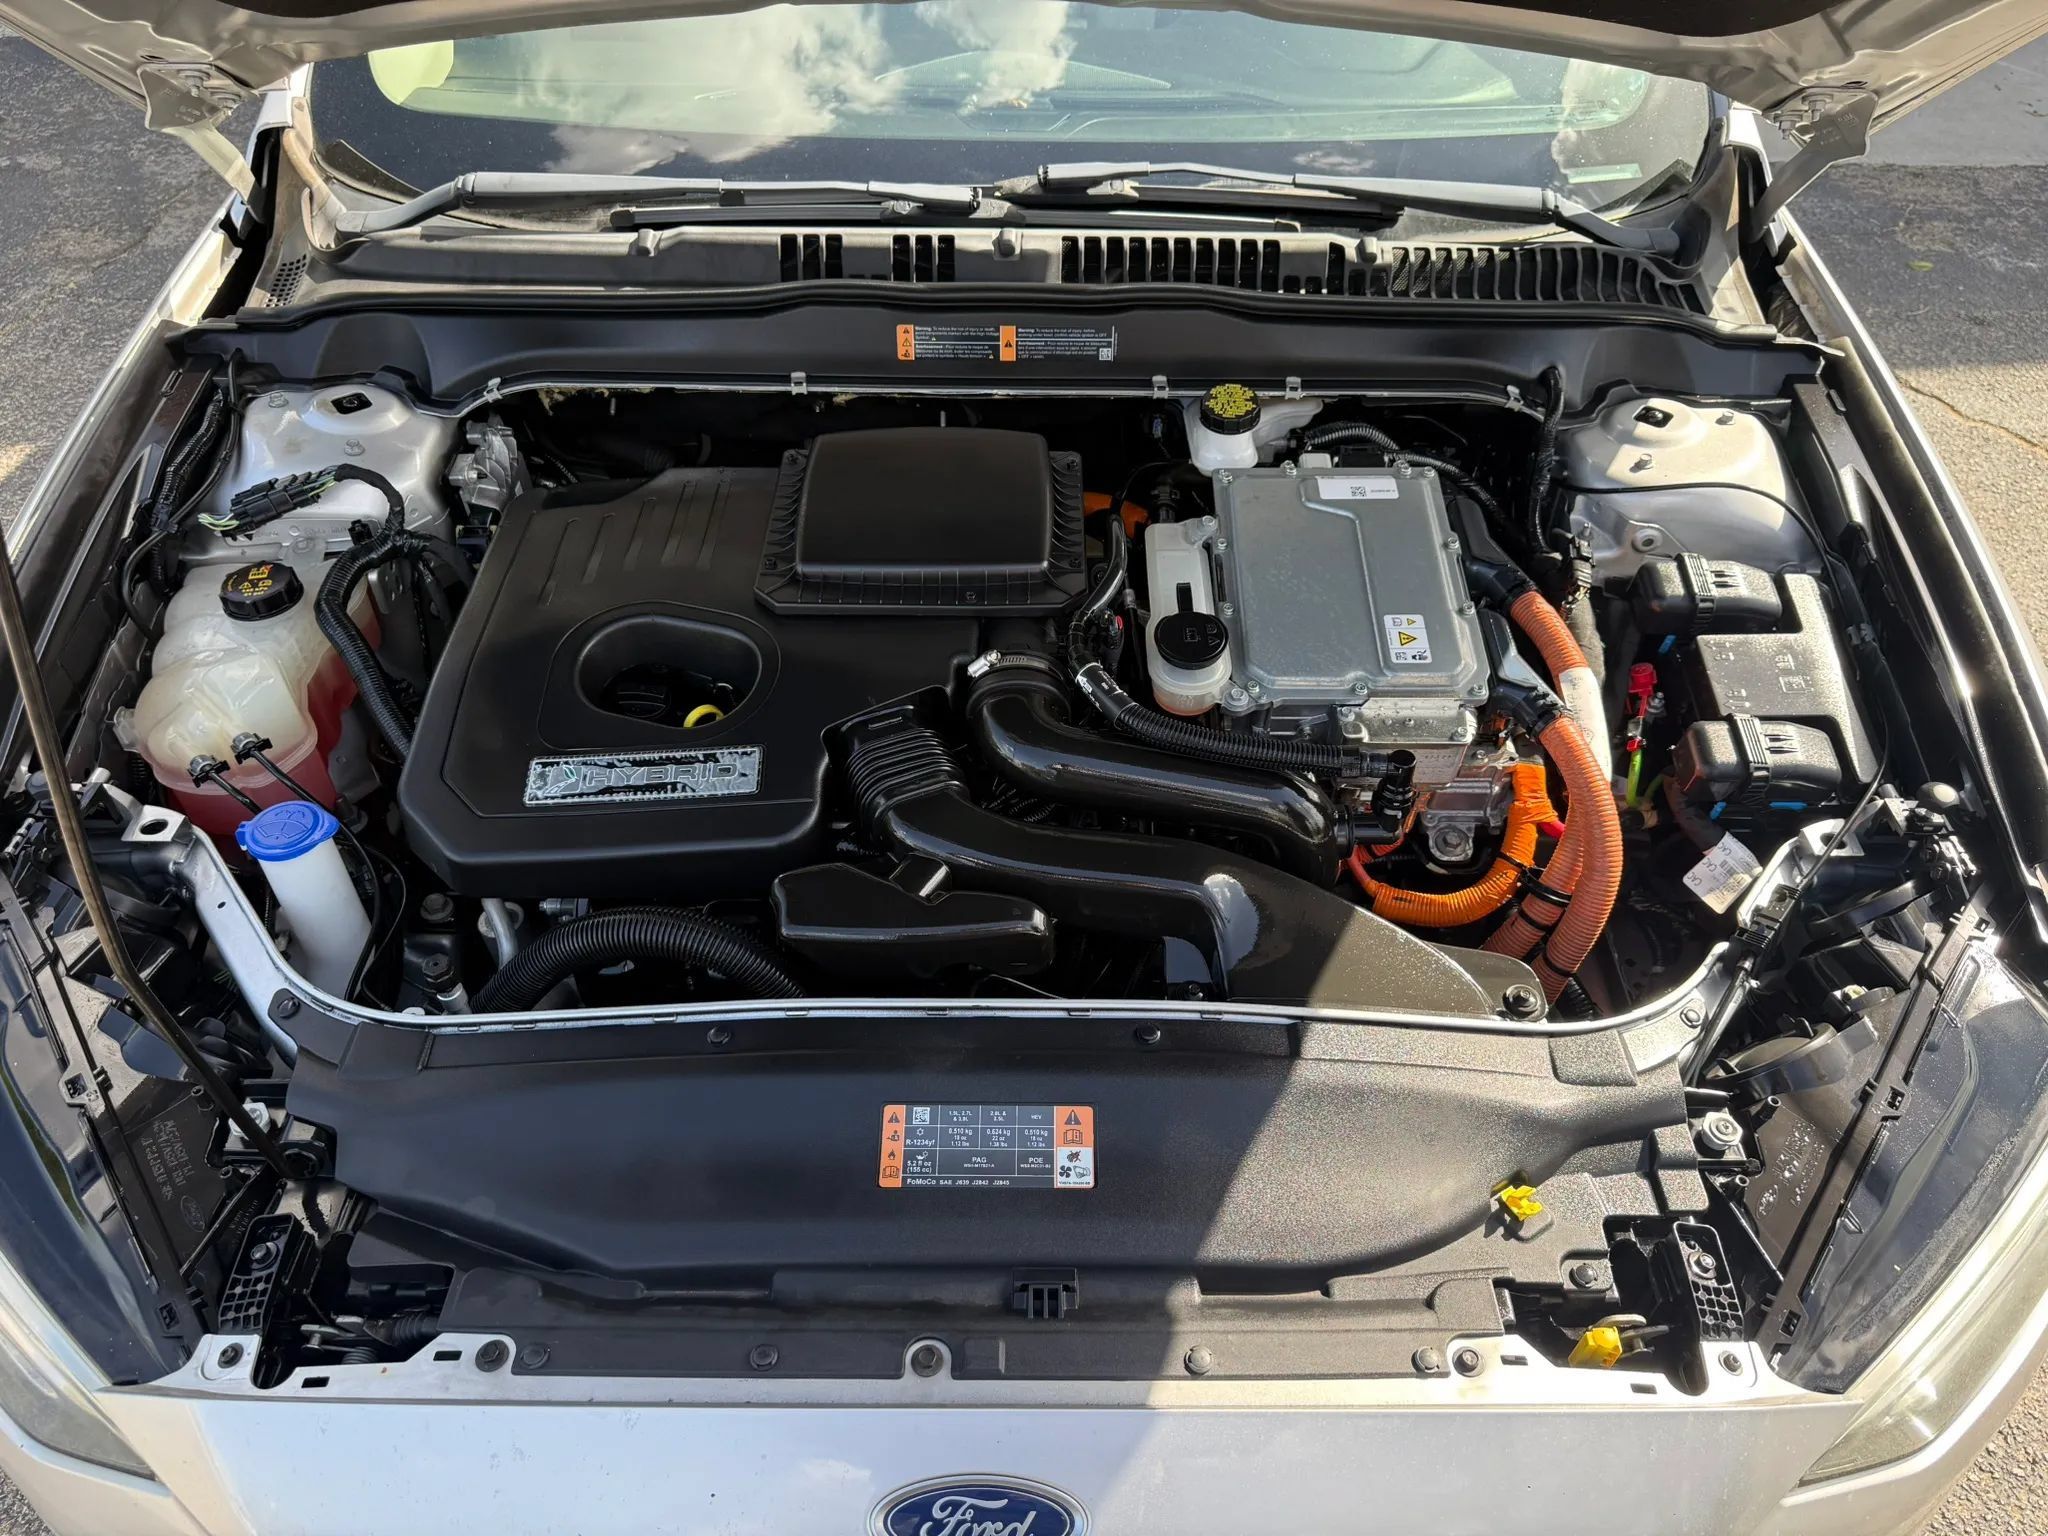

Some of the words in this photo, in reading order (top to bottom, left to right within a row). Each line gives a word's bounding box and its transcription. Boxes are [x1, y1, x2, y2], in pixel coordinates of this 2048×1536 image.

[586, 762, 738, 786] HYBRID
[1702, 858, 1718, 872] CAC
[1686, 872, 1702, 886] CAC
[920, 1496, 1037, 1536] Ford
